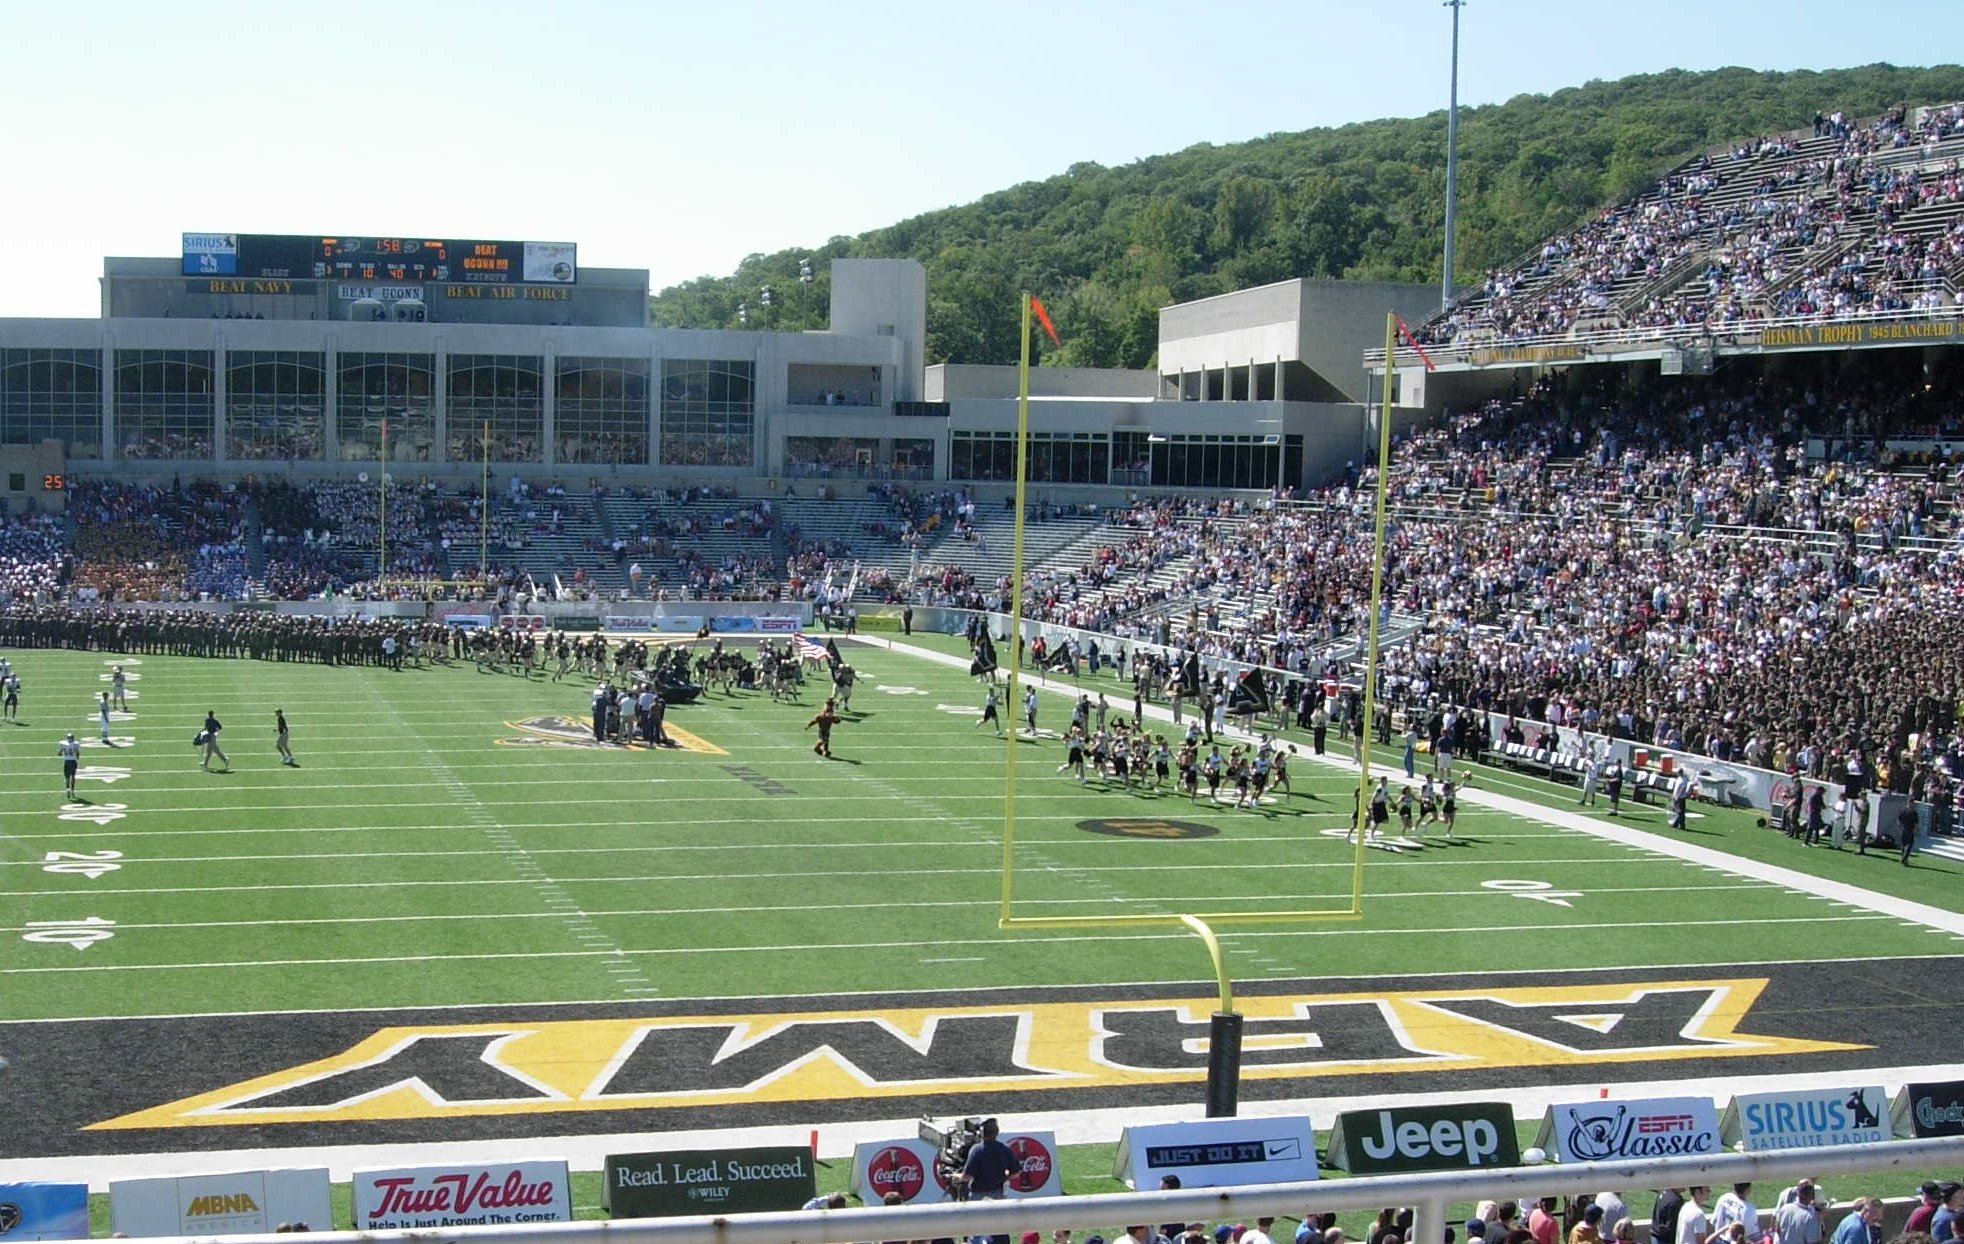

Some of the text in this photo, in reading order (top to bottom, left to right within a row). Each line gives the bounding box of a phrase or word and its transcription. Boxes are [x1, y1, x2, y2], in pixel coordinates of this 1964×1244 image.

[184, 236, 222, 249] SIRIUS
[474, 244, 498, 256] BEAT
[362, 268, 374, 279] 10
[463, 258, 495, 270] UCONN
[389, 269, 404, 279] 40
[209, 280, 292, 294] BEAT NAVY
[341, 287, 373, 298] BEAT
[446, 285, 570, 300] BEAT AIR FORCE
[1762, 326, 1813, 346] HEISMAN
[1818, 324, 1863, 343] TROPHY
[1869, 326, 1889, 339] 1945
[1891, 322, 1954, 339] BLANCHARD
[44, 475, 62, 489] 25
[57, 803, 128, 821] 30
[42, 850, 124, 873] 20
[1480, 879, 1585, 904] 10
[22, 916, 117, 943] 10
[180, 984, 1775, 1118] ARMY
[1637, 1114, 1694, 1134] ESPN
[1746, 1099, 1847, 1136] SIRIUS
[1361, 1111, 1499, 1165] Jeep
[1568, 1115, 1712, 1161] Classic
[1751, 1131, 1882, 1150] SATELLITE RADIO
[1152, 1144, 1261, 1164] JUST DO IT
[617, 1156, 808, 1188] Read. Lead. Succeed.
[368, 1169, 554, 1219] True Value
[699, 1186, 731, 1198] WILEY
[186, 1192, 260, 1217] MBNA
[368, 1211, 562, 1230] Help Is Just Around The Corner.
